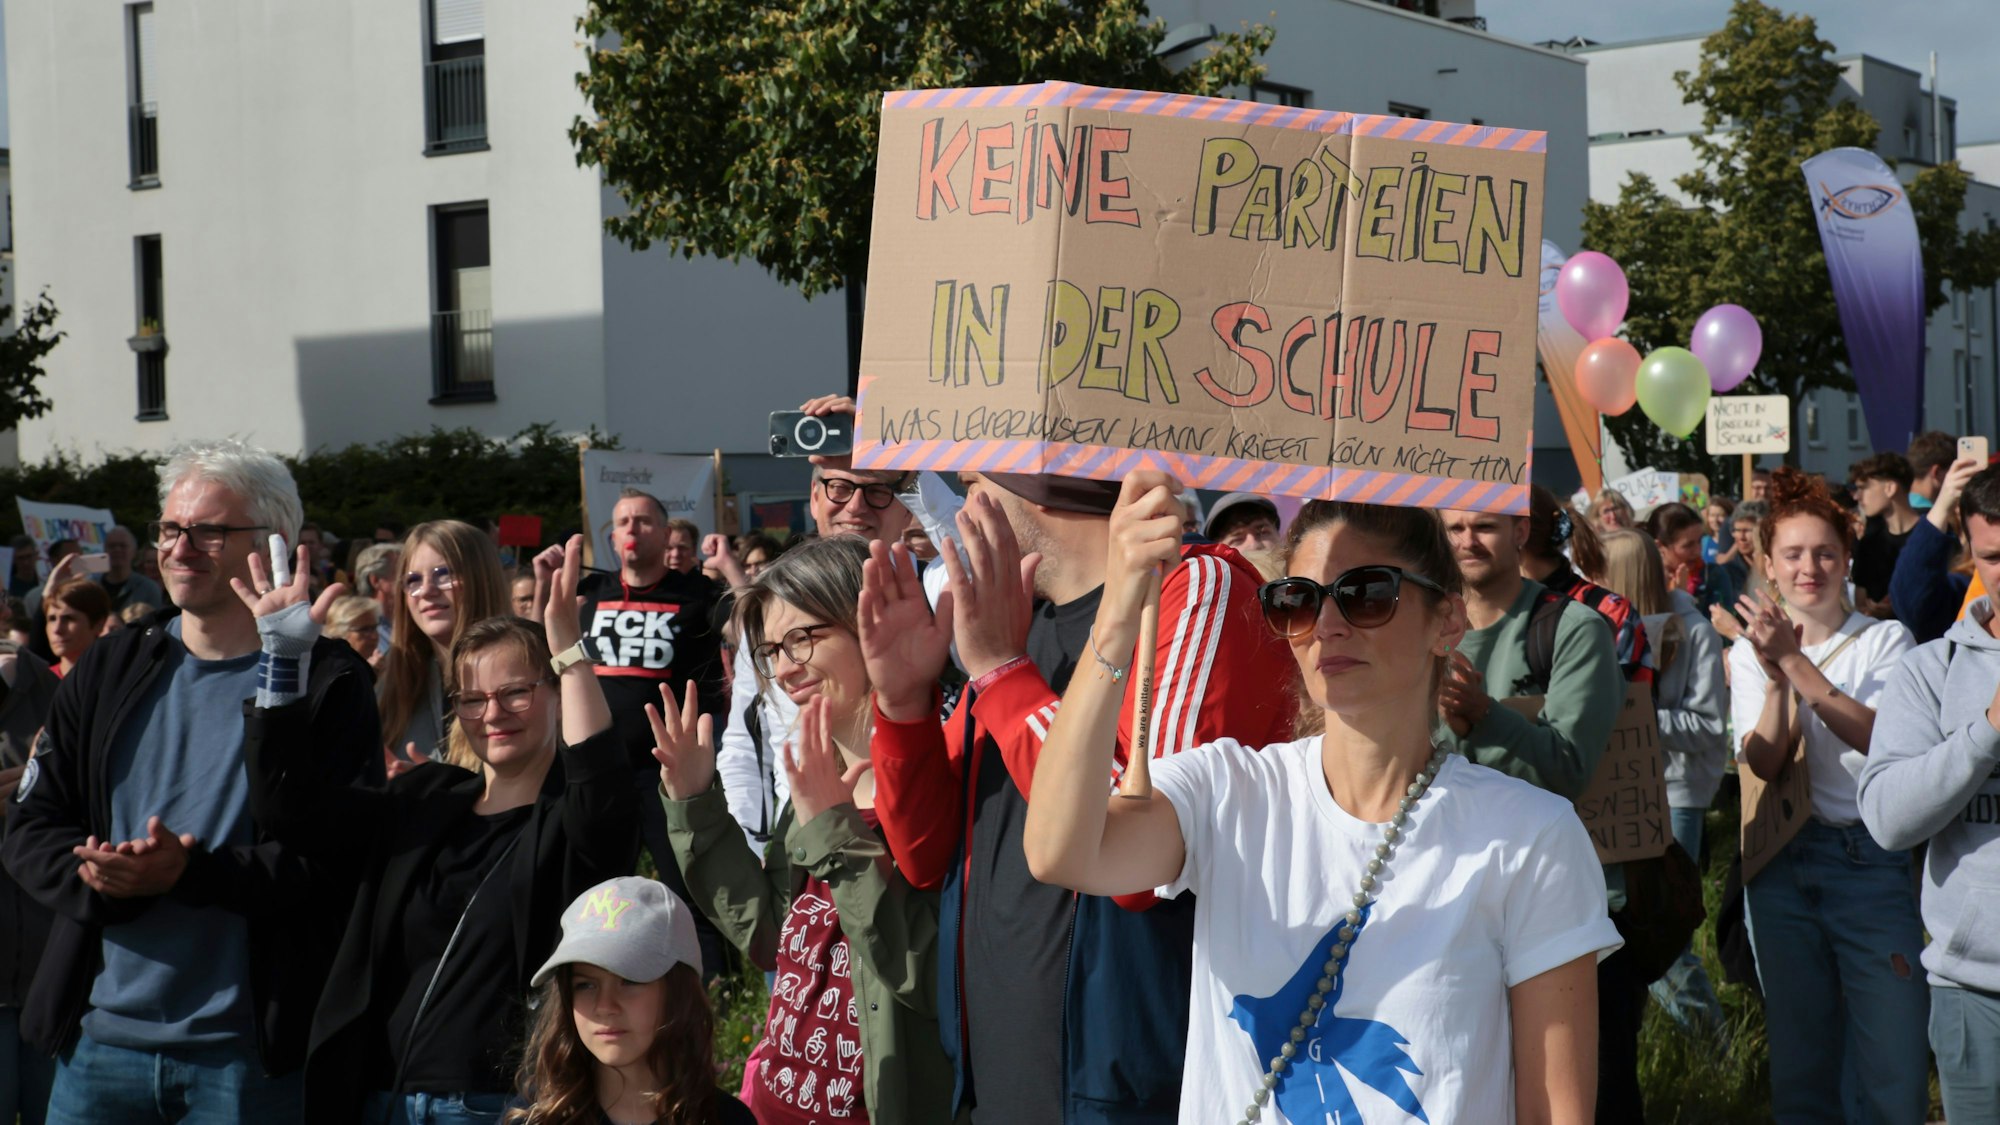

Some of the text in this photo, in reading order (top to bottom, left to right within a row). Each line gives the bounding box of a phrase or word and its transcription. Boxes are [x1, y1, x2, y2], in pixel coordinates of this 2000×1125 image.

[916, 109, 1528, 278] KEINE PARTEIEN
[929, 280, 1502, 442] IN DER SCHULE
[880, 405, 942, 446] WAS
[952, 405, 1121, 443] LEVERKUSEN
[1327, 437, 1384, 467] KÖLN
[1470, 455, 1528, 485] HIN
[590, 610, 676, 640] FCK
[595, 636, 675, 669] AFD
[1140, 677, 1151, 714] knitters
[1137, 734, 1146, 749] we
[1139, 716, 1148, 734] are
[1606, 724, 1652, 752] ILL
[1609, 756, 1656, 781] IST
[576, 885, 636, 932] NY
